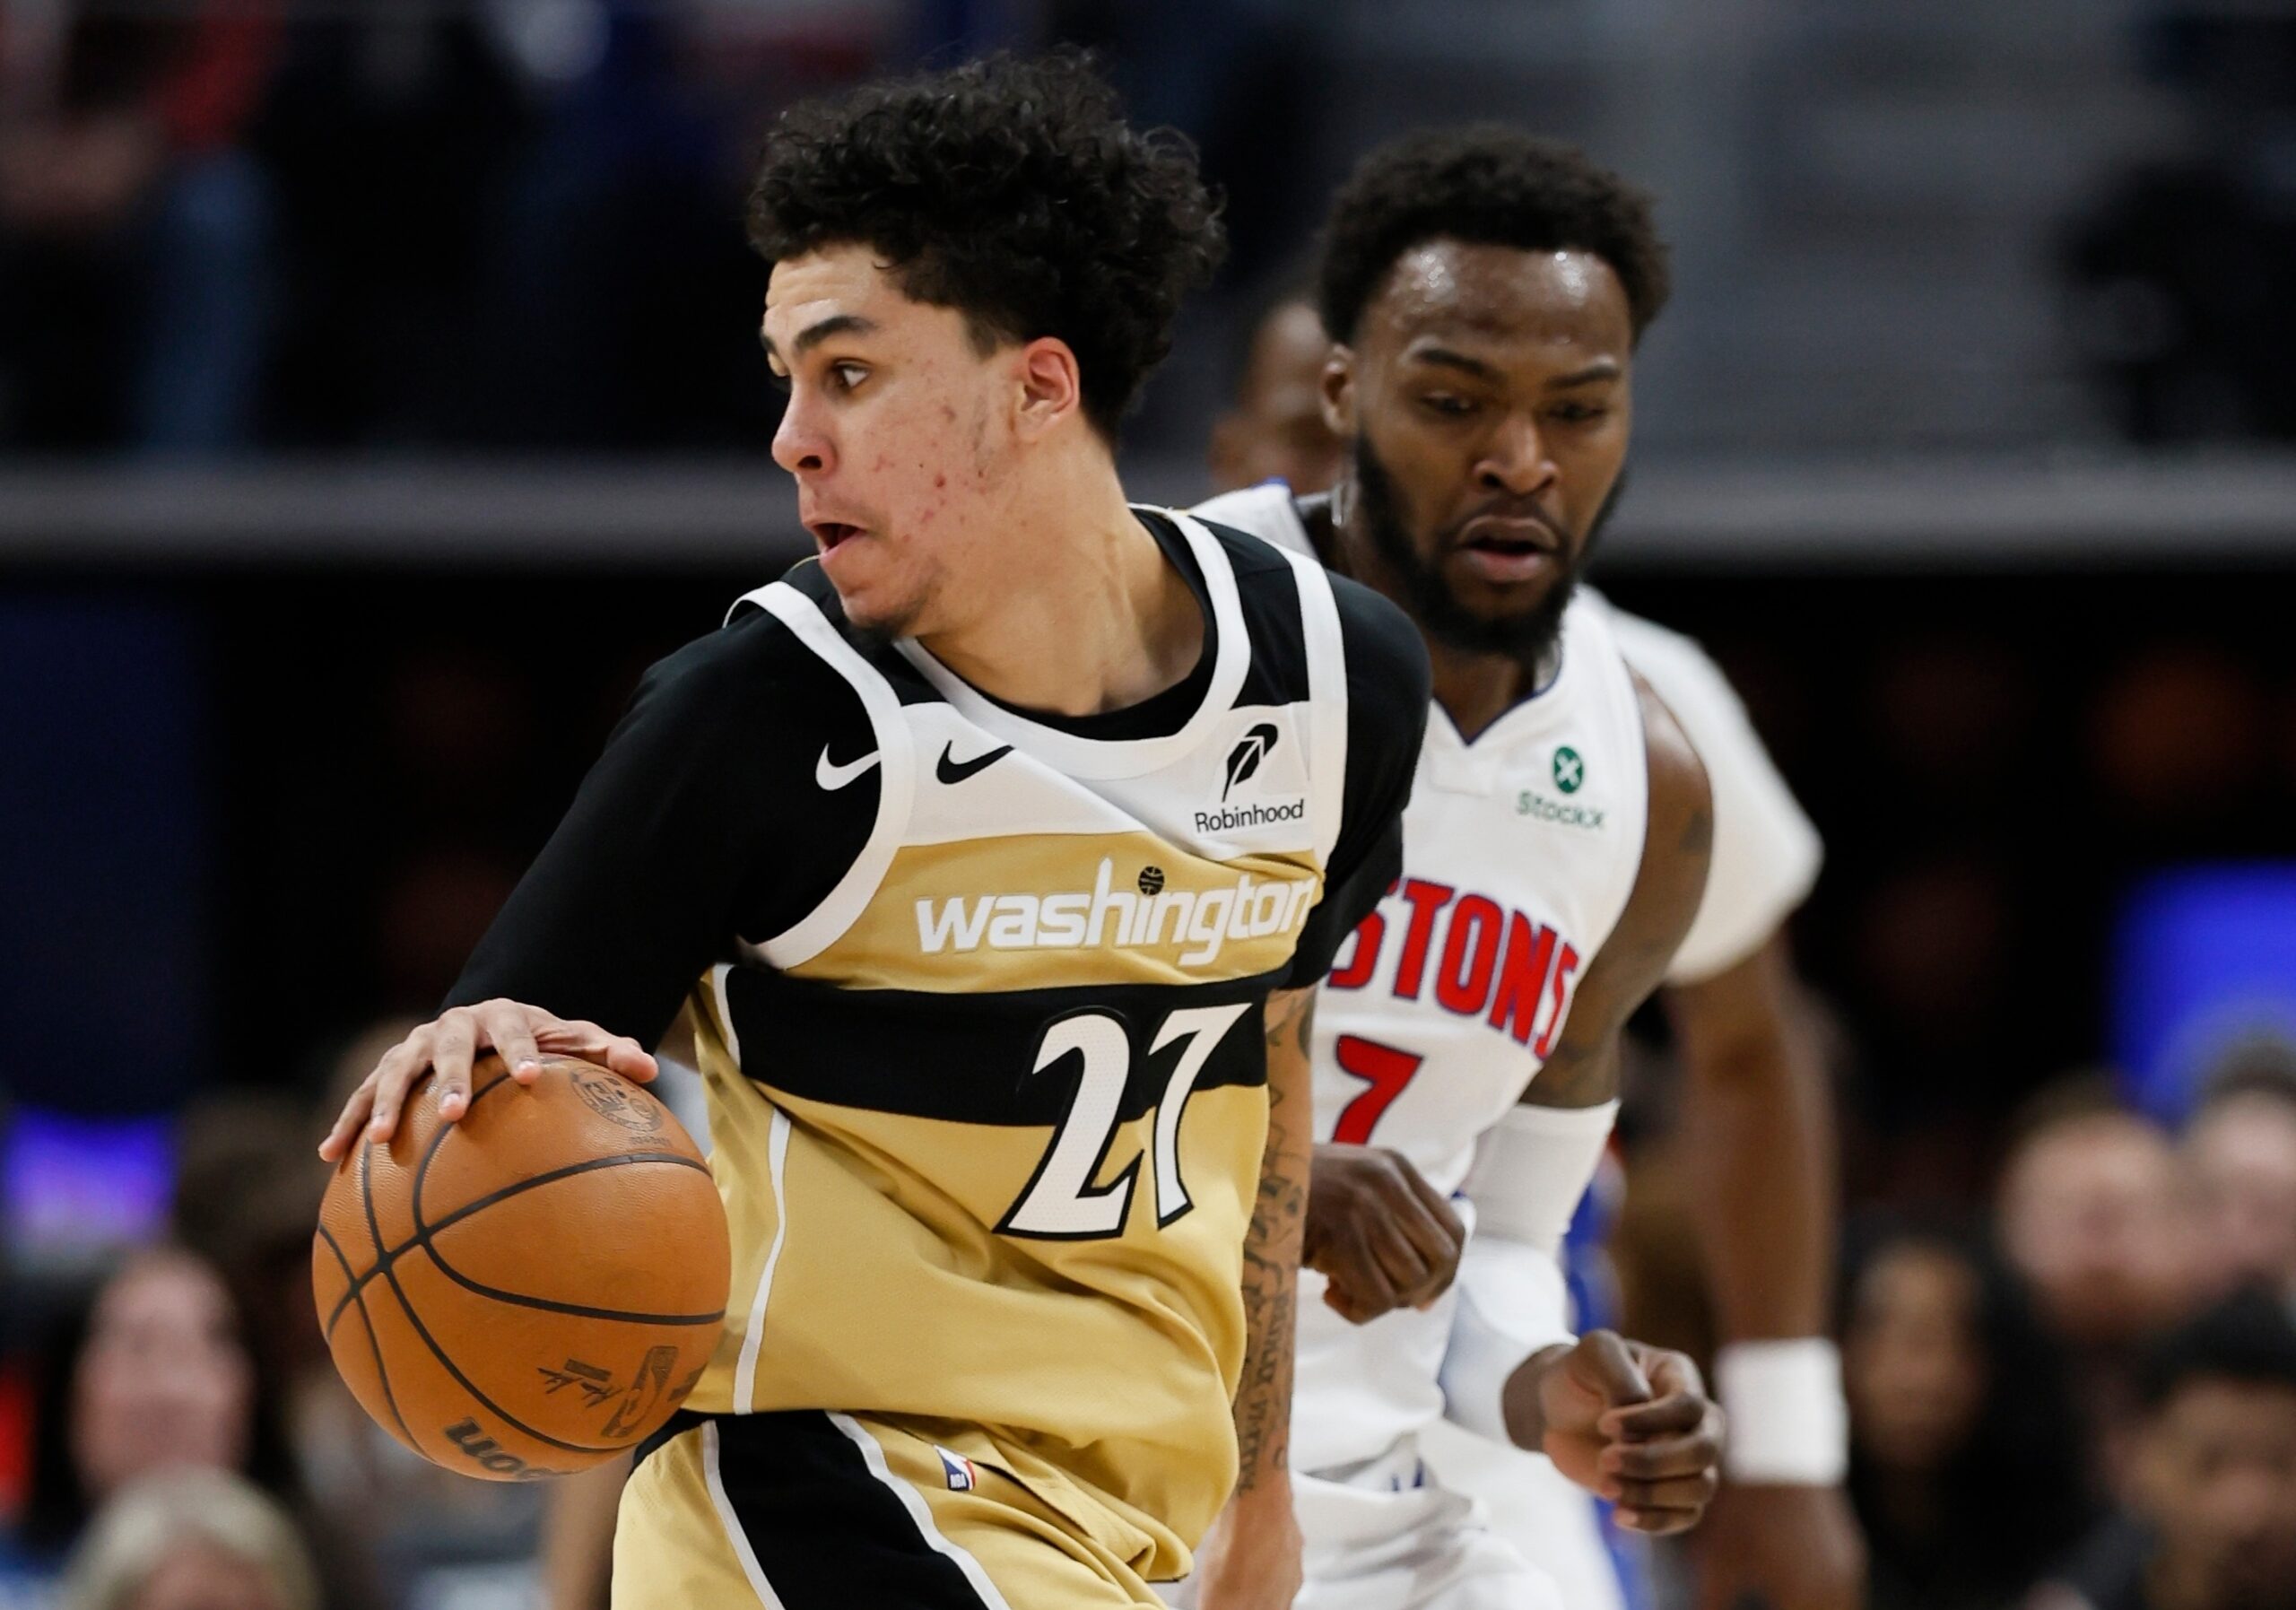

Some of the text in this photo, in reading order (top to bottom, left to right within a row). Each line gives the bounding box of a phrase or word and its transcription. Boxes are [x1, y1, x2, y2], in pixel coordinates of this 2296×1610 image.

[1195, 798, 1304, 832] Robinhood
[915, 857, 1318, 967] washington
[992, 1000, 1254, 1241] 27
[1335, 1034, 1424, 1145] 7
